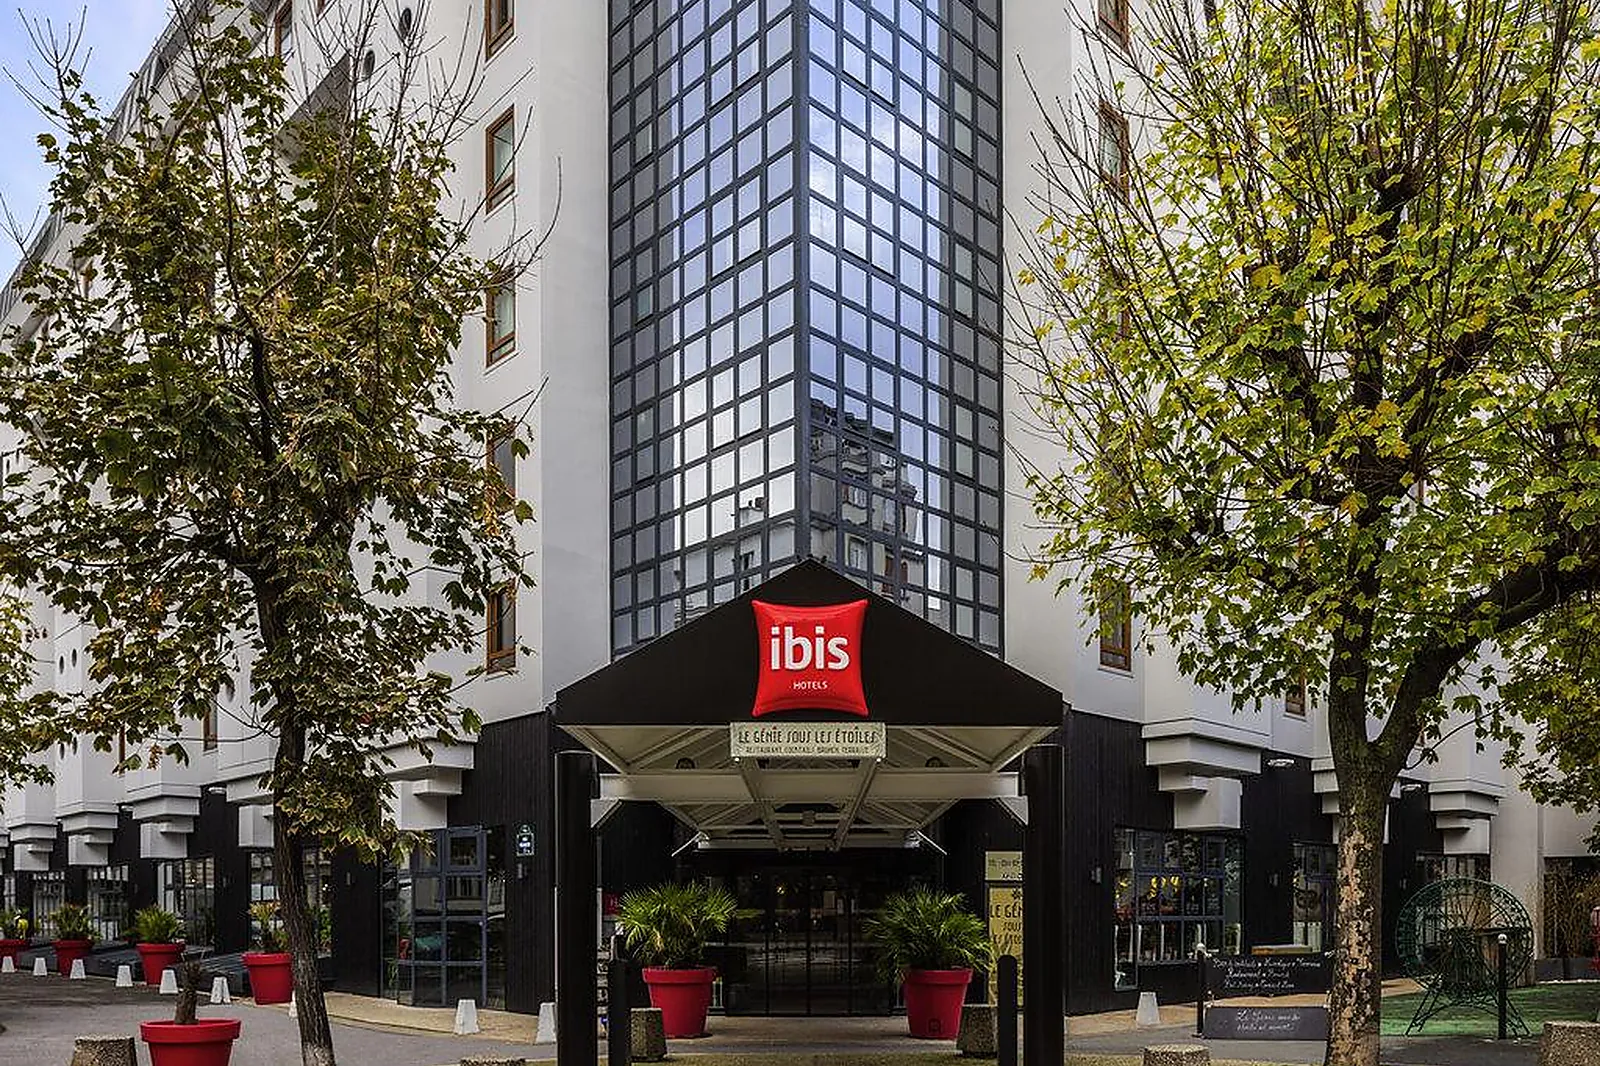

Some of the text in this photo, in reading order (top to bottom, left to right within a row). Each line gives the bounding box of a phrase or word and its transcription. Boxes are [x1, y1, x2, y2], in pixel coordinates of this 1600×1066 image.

[771, 626, 850, 670] ibis
[793, 681, 828, 690] HOTELS
[739, 731, 750, 743] LE
[786, 731, 812, 743] SOUS
[815, 731, 832, 743] LES
[990, 904, 1001, 918] LE
